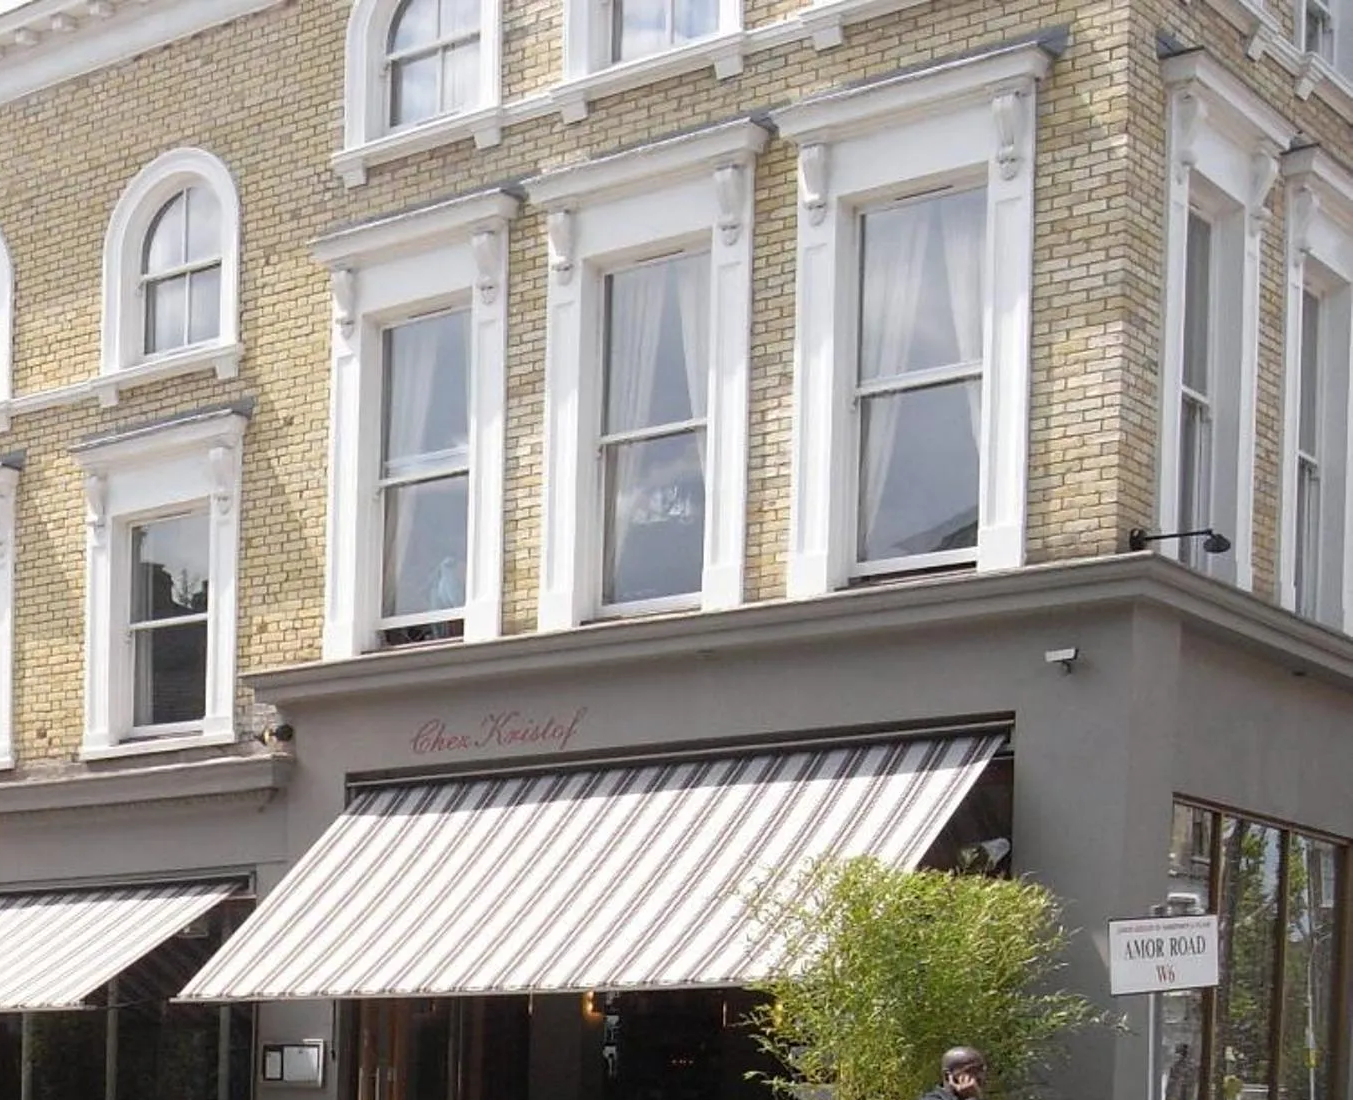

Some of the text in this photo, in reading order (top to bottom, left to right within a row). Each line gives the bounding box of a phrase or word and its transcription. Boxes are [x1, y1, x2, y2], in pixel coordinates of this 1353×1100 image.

[411, 706, 588, 754] Chez Kristof
[1125, 935, 1206, 960] AMOR ROAD
[1155, 963, 1176, 984] W6
